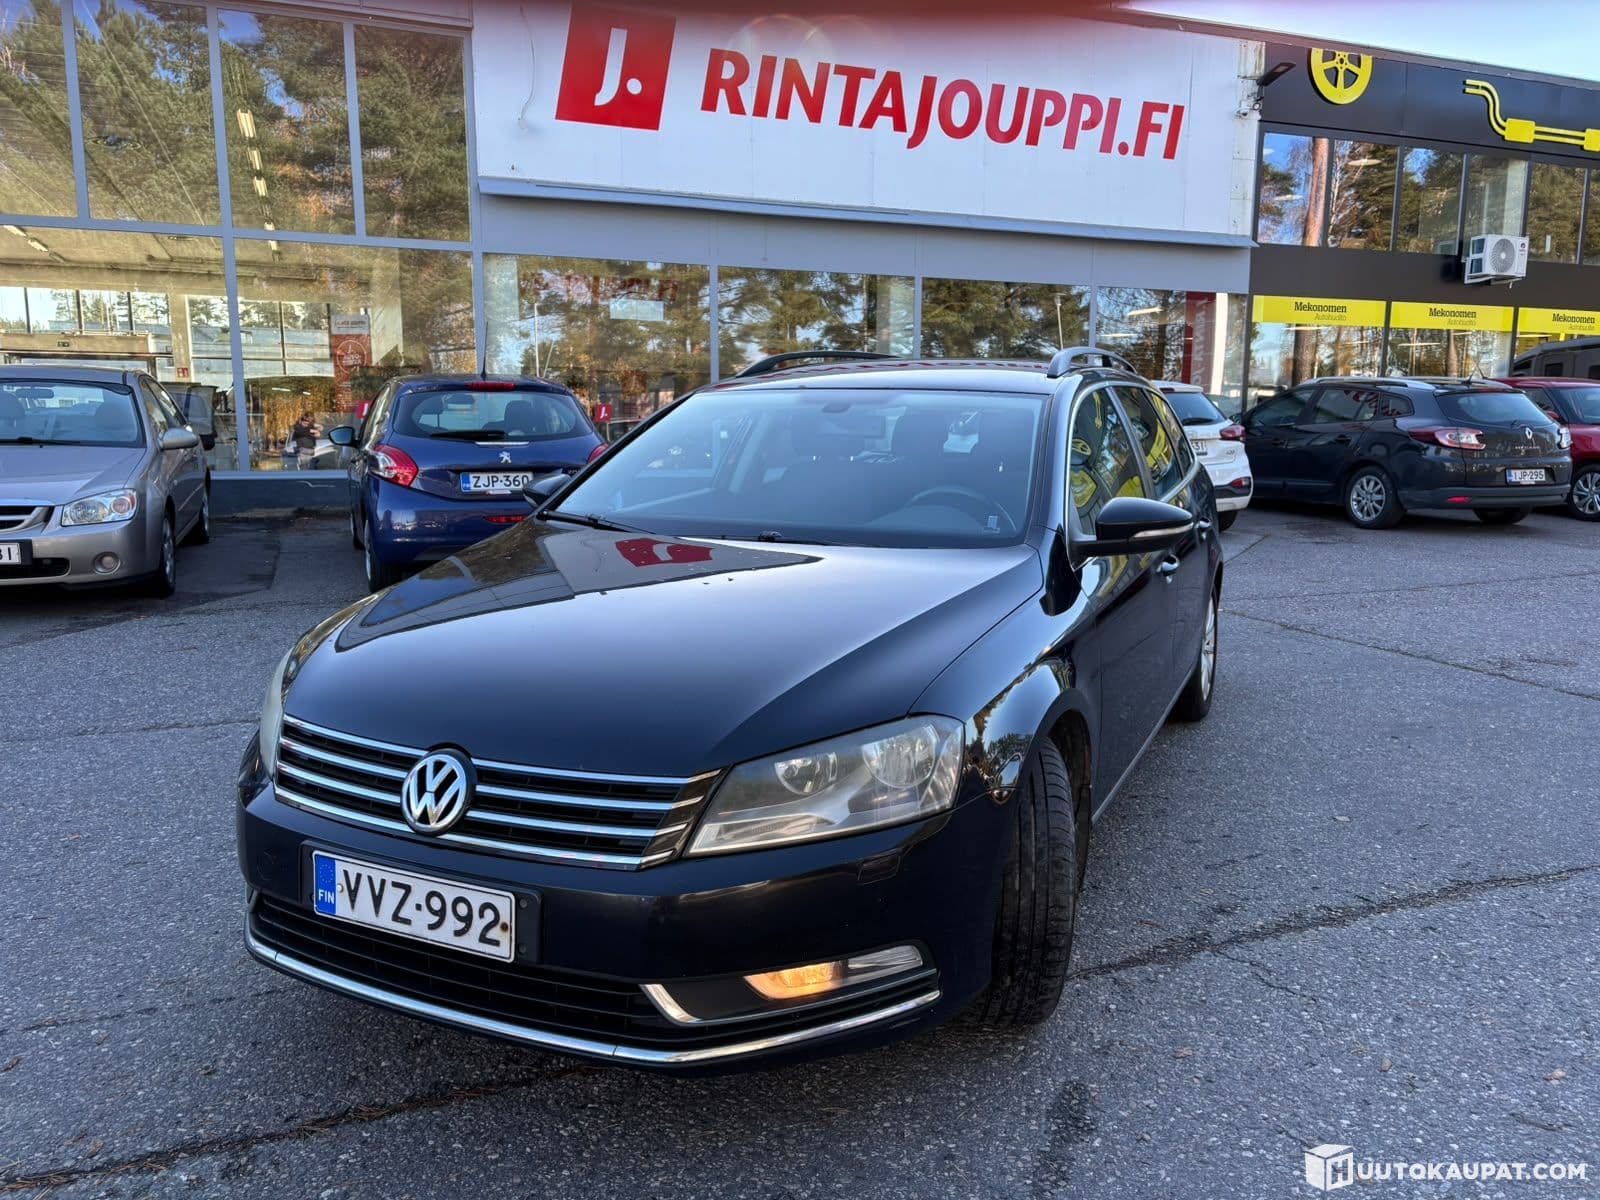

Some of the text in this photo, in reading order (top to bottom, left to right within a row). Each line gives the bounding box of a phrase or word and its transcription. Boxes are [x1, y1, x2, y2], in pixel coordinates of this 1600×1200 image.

[701, 47, 1185, 160] RINTAJOUPPI.FI
[1294, 302, 1347, 313] Mekonomen
[1428, 308, 1477, 319] Mekonomen
[1552, 313, 1596, 324] Mekonomen
[318, 888, 336, 905] FIN
